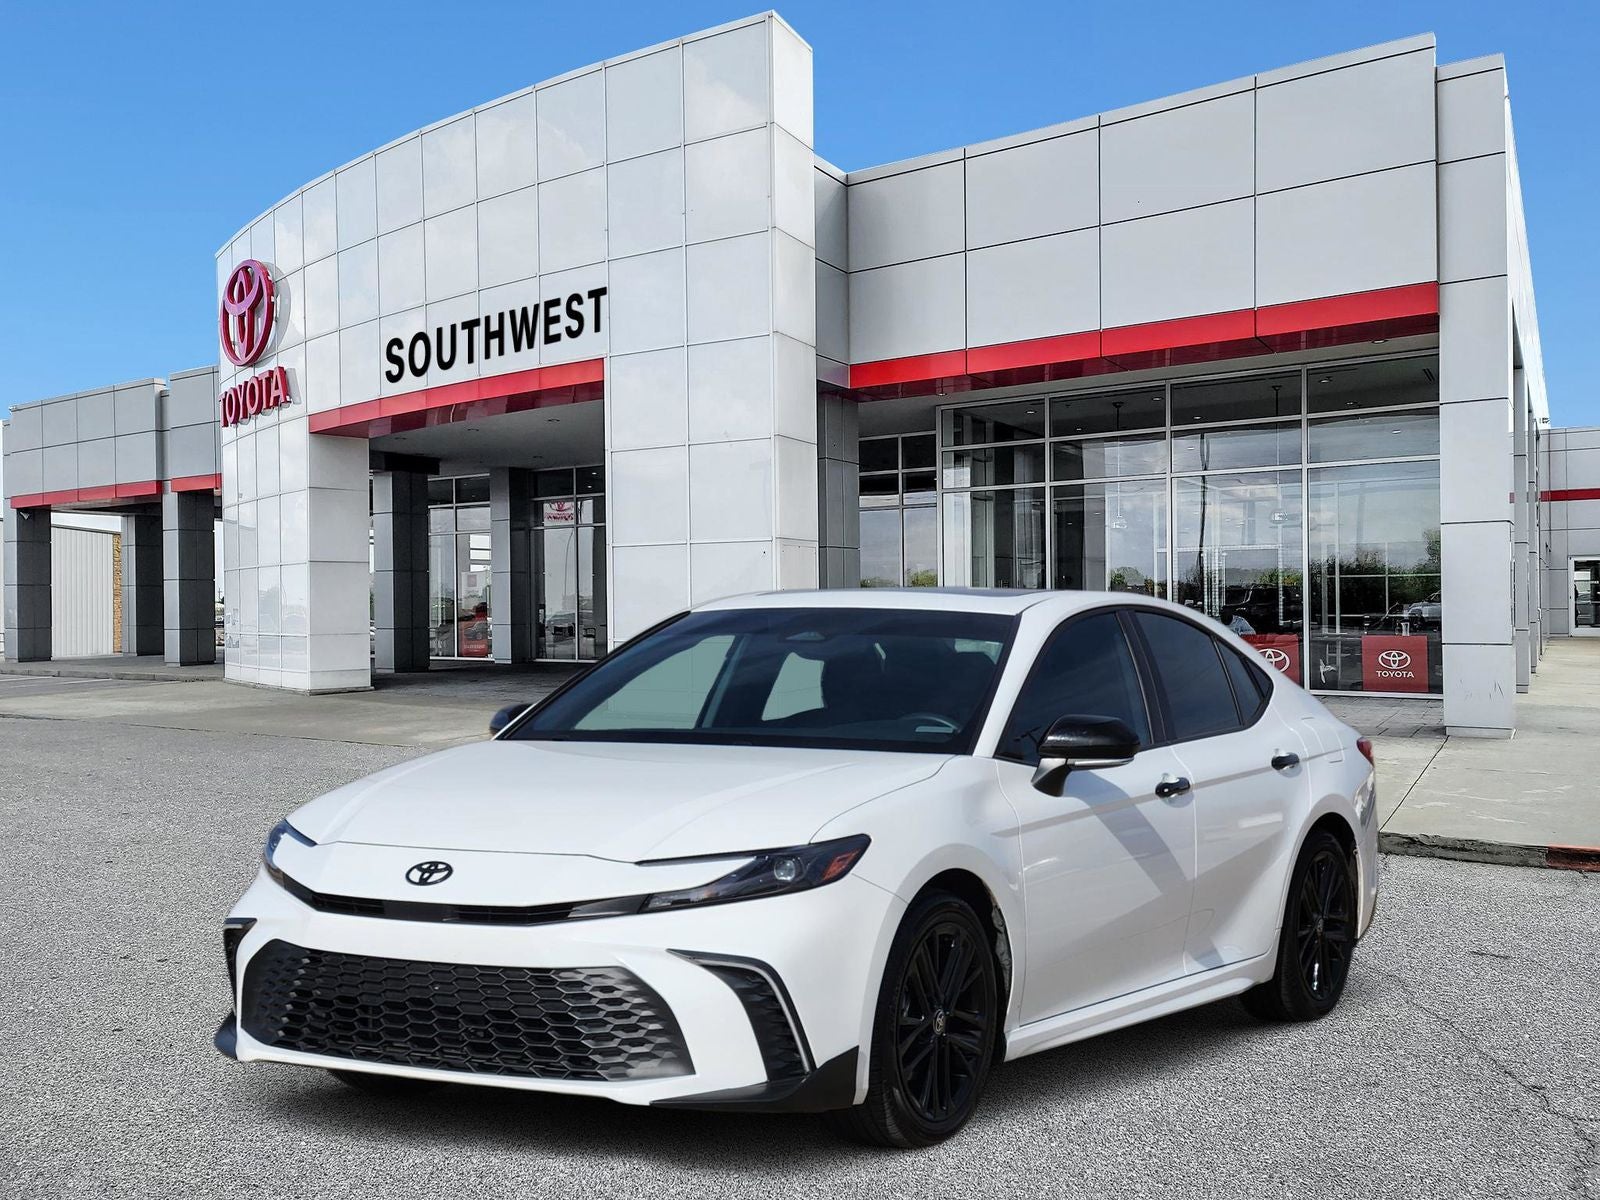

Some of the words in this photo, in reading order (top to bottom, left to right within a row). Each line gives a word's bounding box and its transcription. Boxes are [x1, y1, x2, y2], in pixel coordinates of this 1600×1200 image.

[385, 286, 608, 384] SOUTHWEST
[219, 366, 290, 428] TOYOTA
[1375, 670, 1415, 679] TOYOTA
